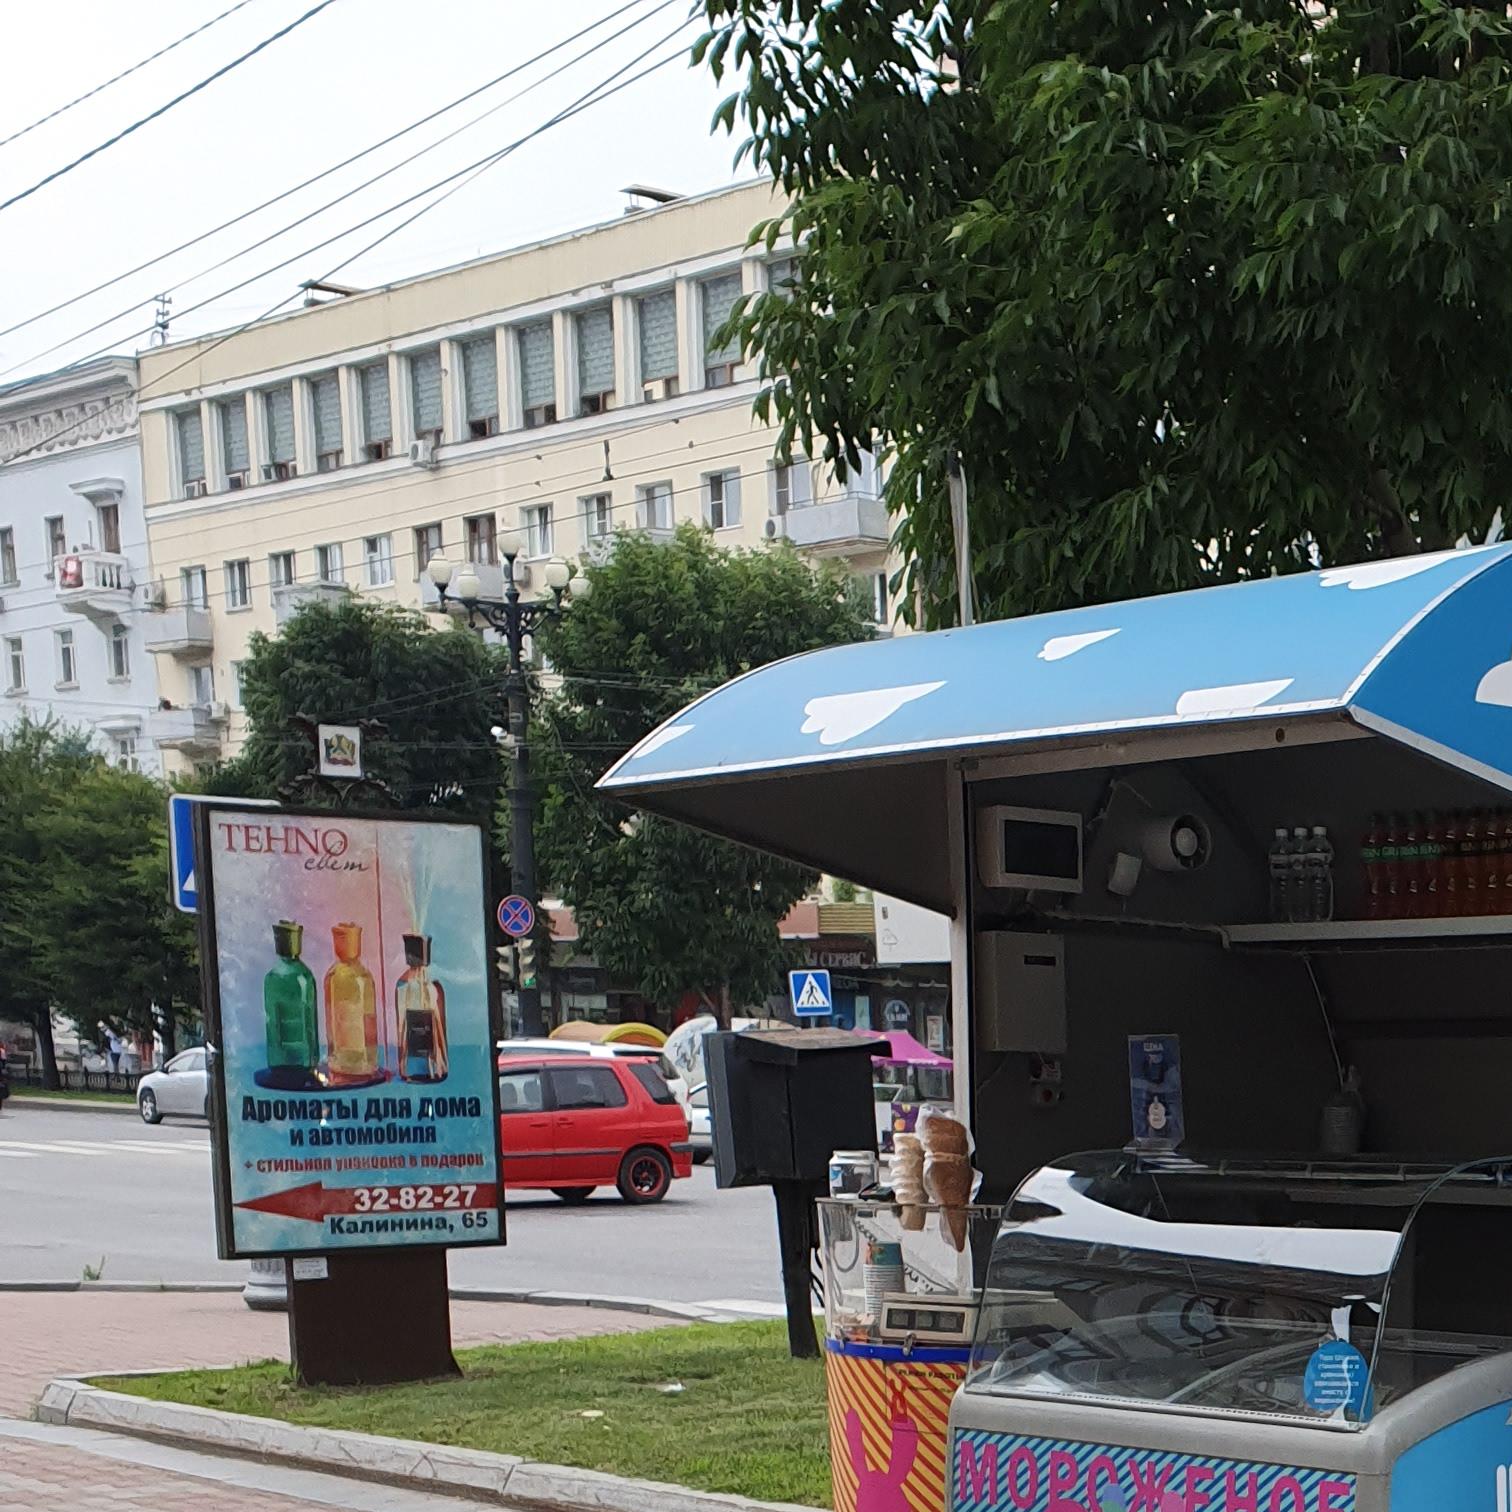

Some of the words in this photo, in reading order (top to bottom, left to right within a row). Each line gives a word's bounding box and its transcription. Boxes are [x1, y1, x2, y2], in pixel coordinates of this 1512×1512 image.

[218, 822, 349, 856] TEHNO
[242, 1096, 359, 1123] Ароматы
[364, 1097, 412, 1122] для
[418, 1096, 480, 1121] дома
[290, 1129, 304, 1146] и
[309, 1123, 437, 1146] автомобиля
[421, 1153, 484, 1168] подарок
[354, 1185, 477, 1211] 32-82-27
[331, 1216, 455, 1234] Калинина,
[462, 1212, 488, 1229] 65
